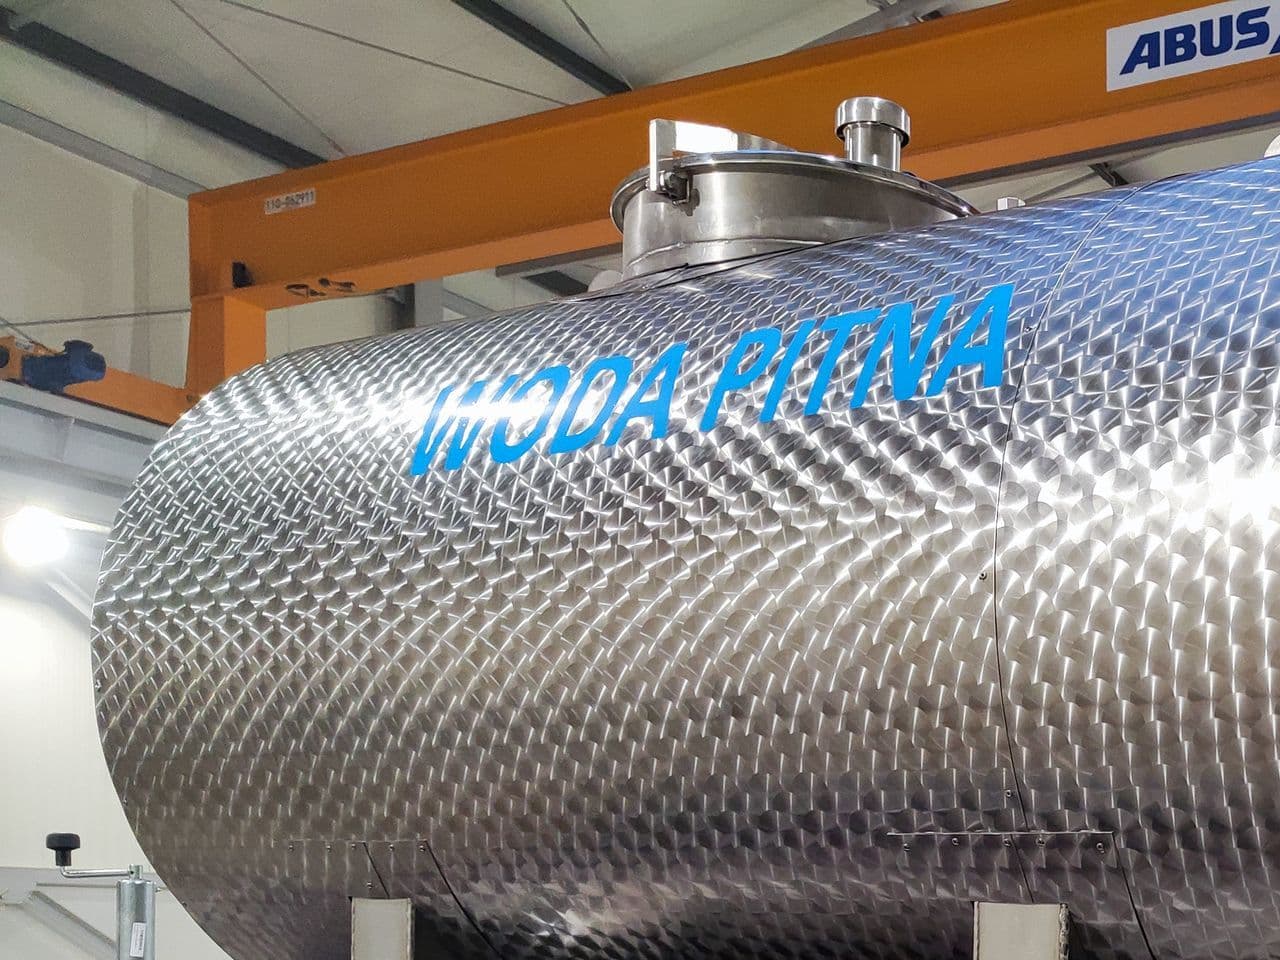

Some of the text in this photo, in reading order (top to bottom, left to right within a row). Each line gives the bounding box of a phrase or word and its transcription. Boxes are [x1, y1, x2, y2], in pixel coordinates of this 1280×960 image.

[1119, 6, 1271, 75] ABUS
[410, 283, 1015, 476] WODA PITNA
